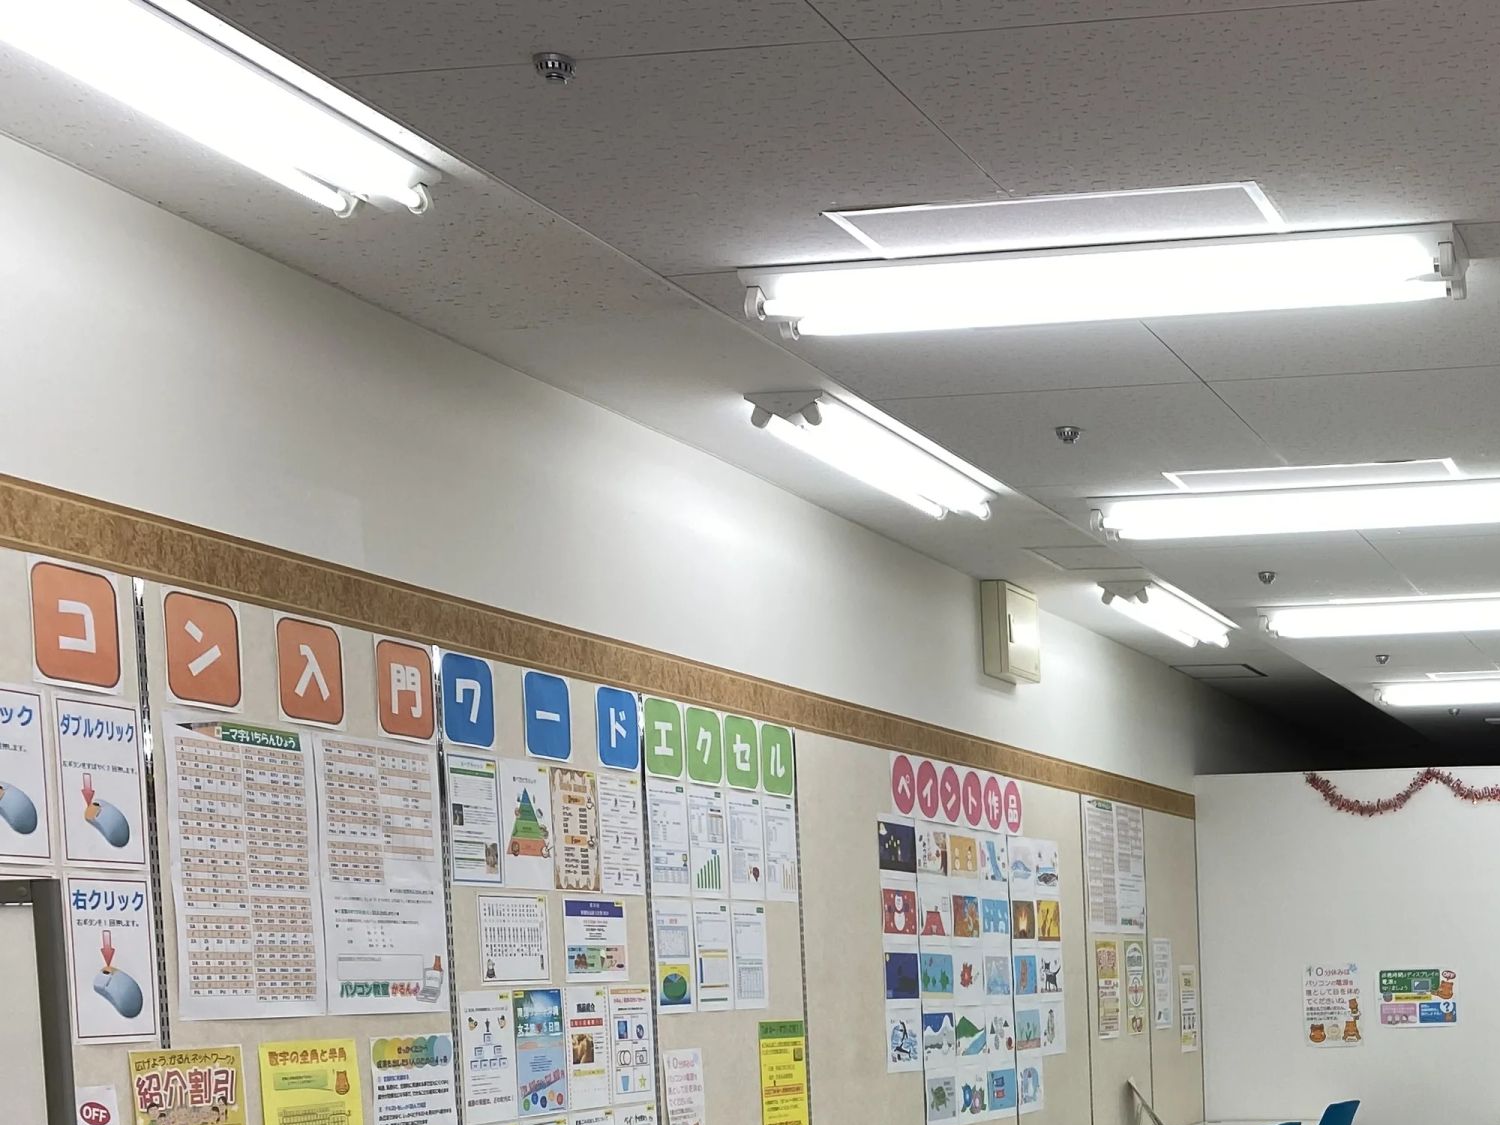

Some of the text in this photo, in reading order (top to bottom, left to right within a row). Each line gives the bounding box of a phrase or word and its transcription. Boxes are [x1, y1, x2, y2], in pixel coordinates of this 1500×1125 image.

[60, 713, 134, 743] ダブルクリック
[653, 720, 786, 778] エクセル
[897, 774, 1019, 823] ペイント作品
[72, 889, 144, 912] 右クリック
[268, 1047, 347, 1066] 数字の全角と半角
[136, 1068, 236, 1110] 紹介割引
[82, 1106, 107, 1123] OFF
